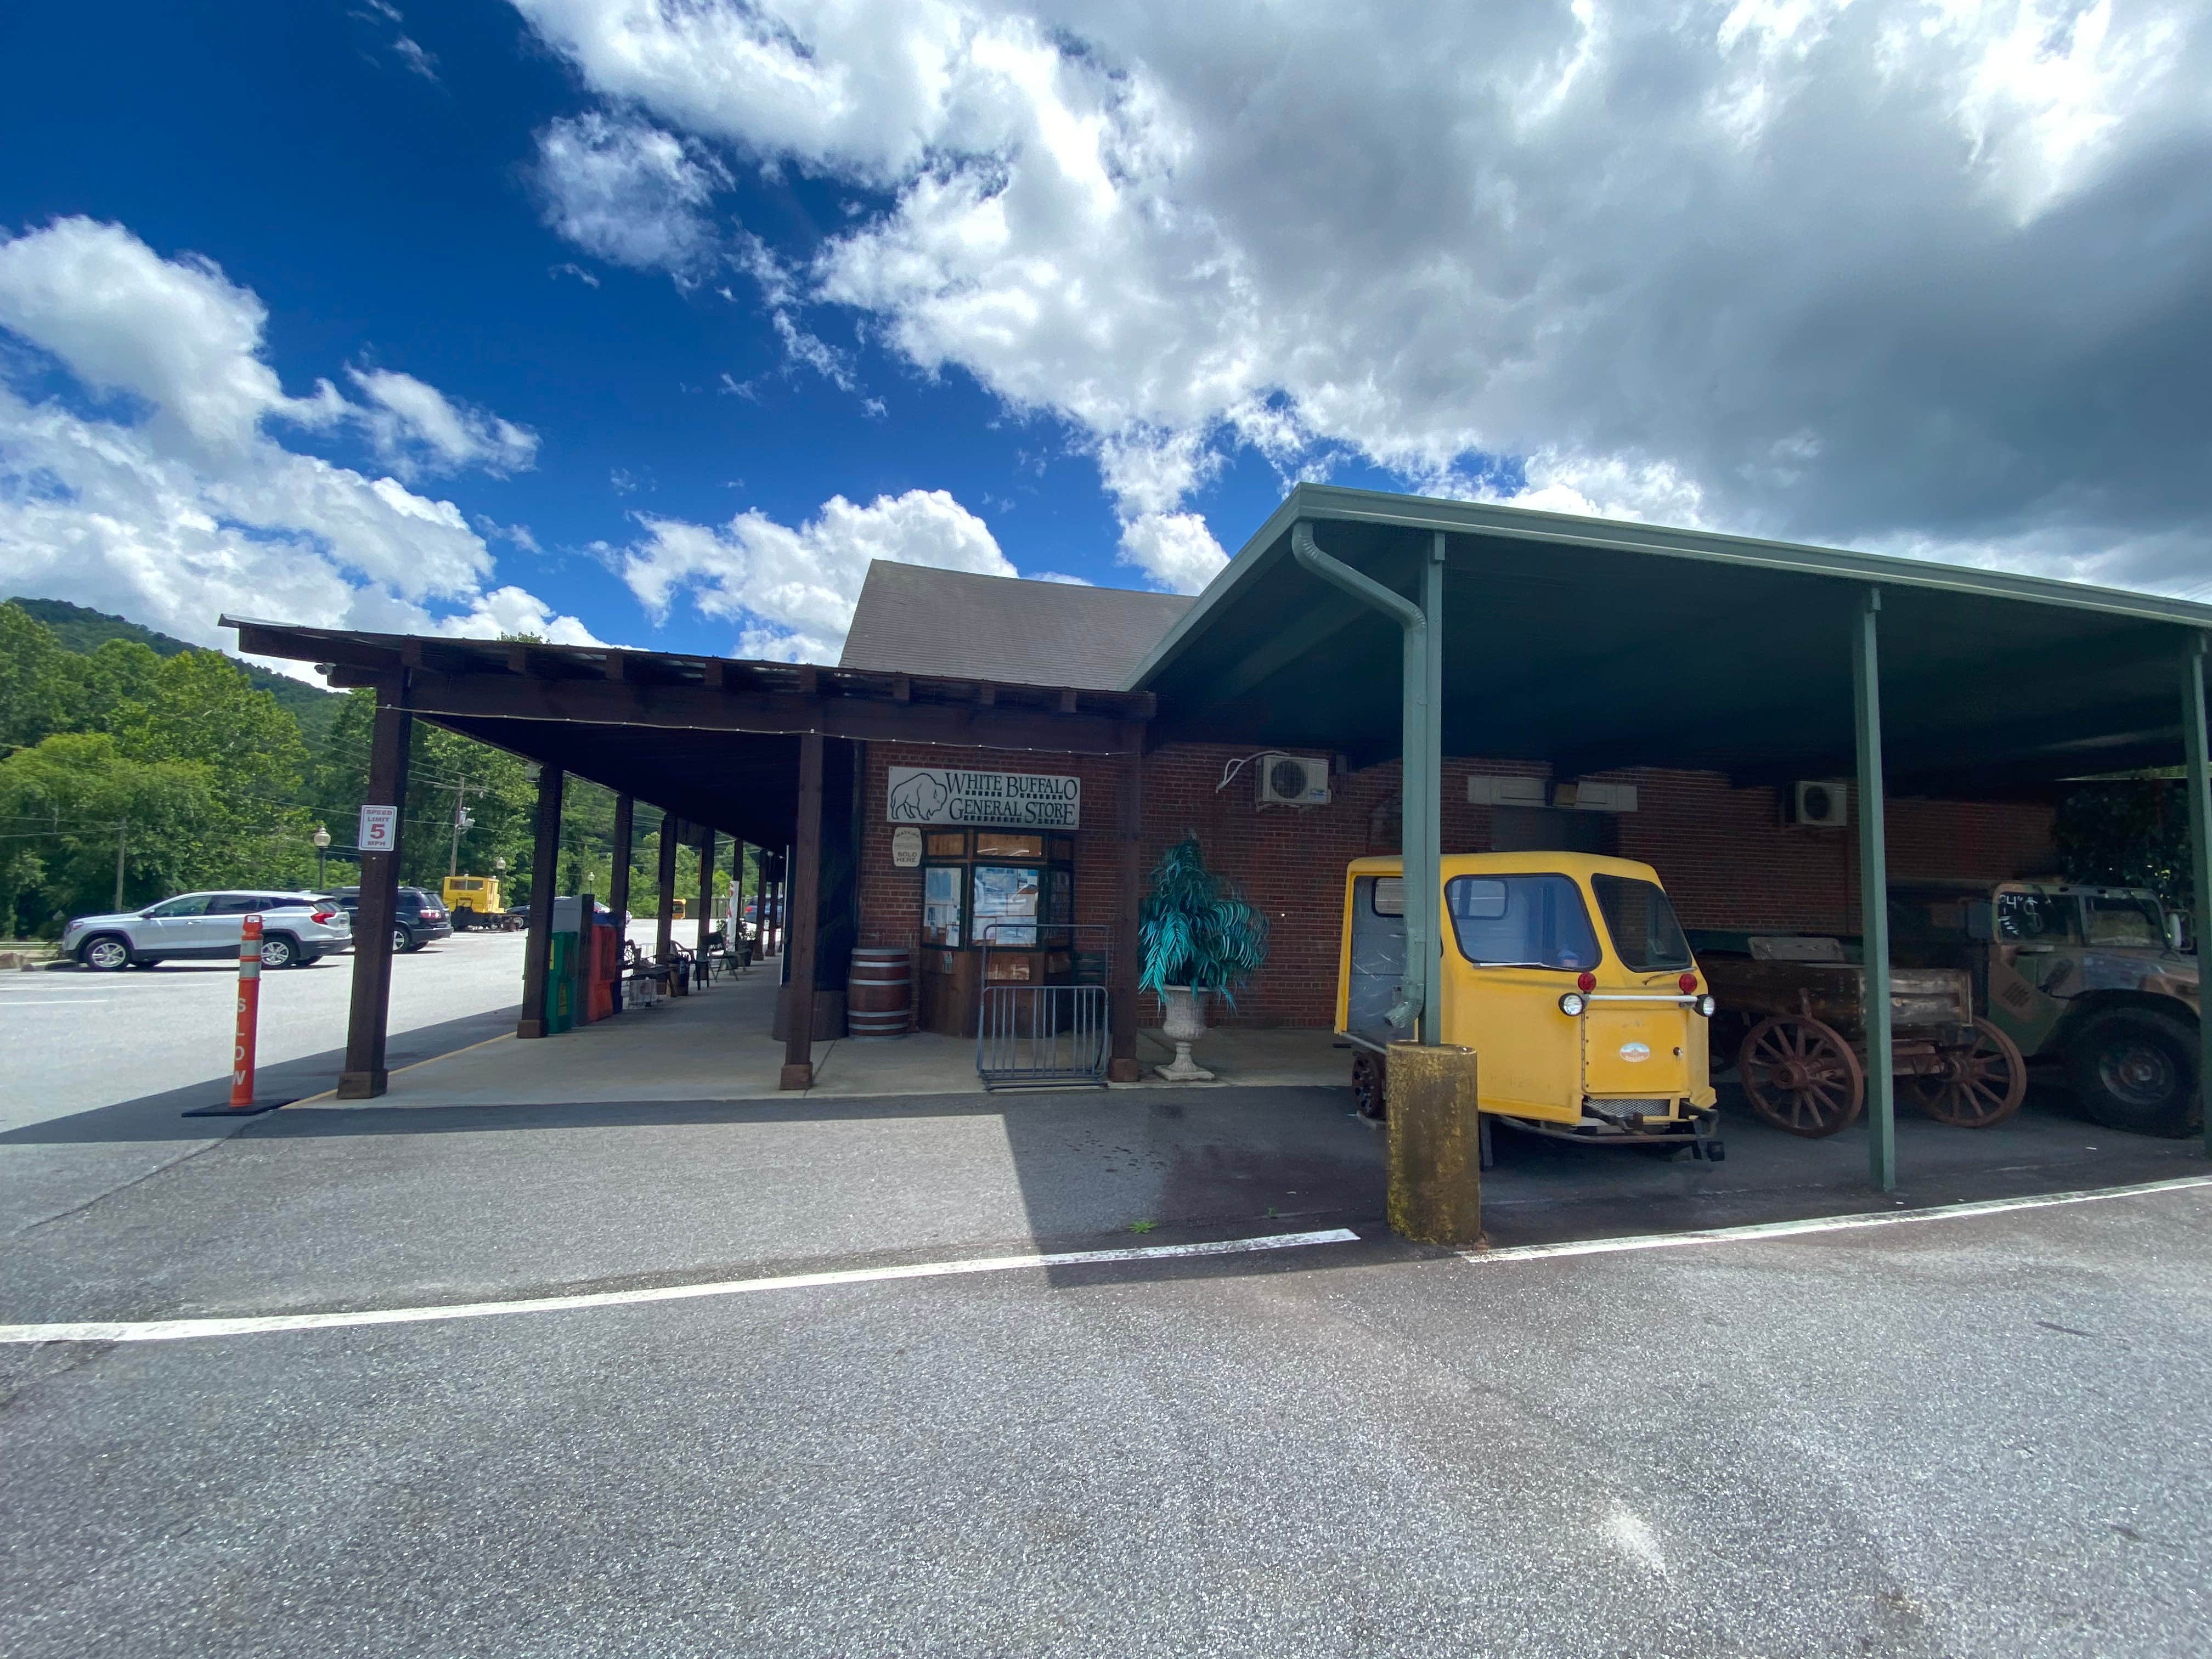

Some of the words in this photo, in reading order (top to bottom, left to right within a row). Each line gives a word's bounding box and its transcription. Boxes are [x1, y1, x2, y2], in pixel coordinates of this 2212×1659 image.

[945, 772, 1002, 795] WHITE
[1005, 776, 1077, 800] BUFFALO
[949, 798, 1022, 820] GENERAL
[1025, 802, 1076, 826] STORE
[370, 823, 385, 839] 5
[232, 997, 246, 1086] SLOW
